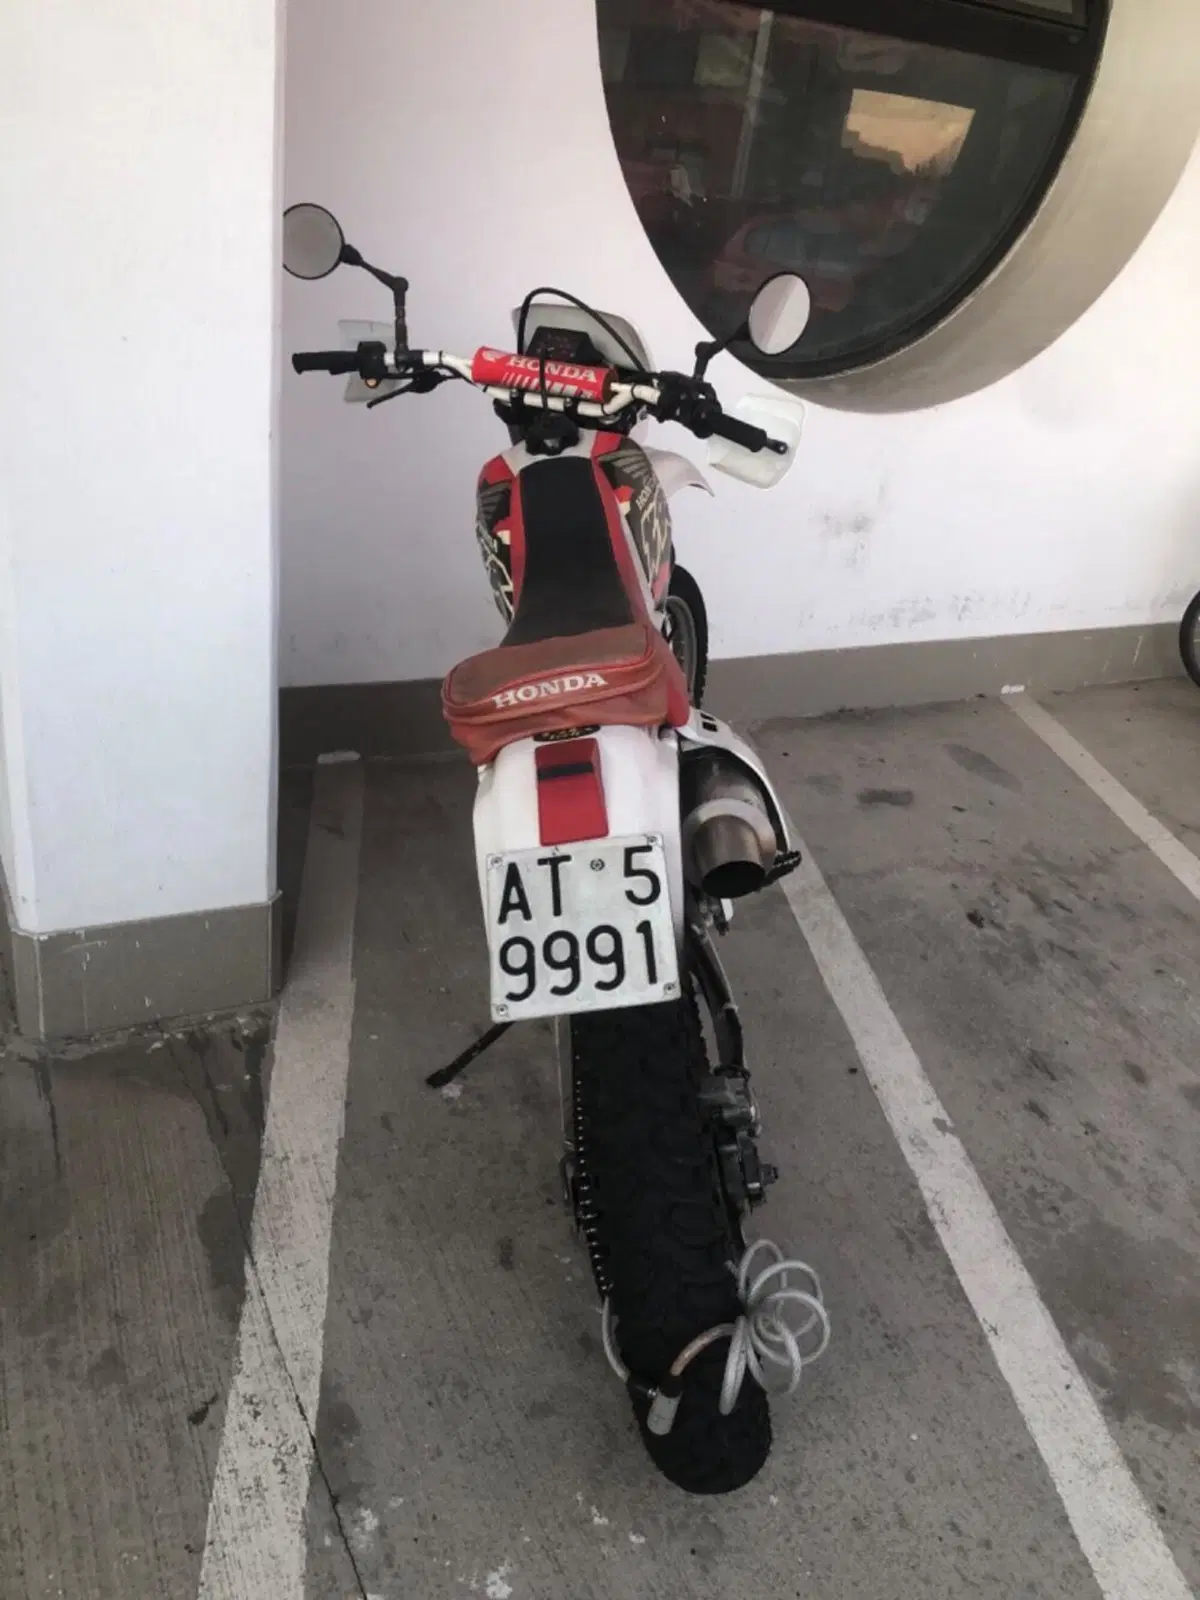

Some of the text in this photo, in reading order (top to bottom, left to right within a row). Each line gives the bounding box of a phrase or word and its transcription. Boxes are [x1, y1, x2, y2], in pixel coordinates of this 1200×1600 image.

[505, 355, 597, 383] HONDA
[492, 673, 608, 709] HONDA
[497, 845, 661, 925] AT 5
[499, 919, 658, 1002] 9991
